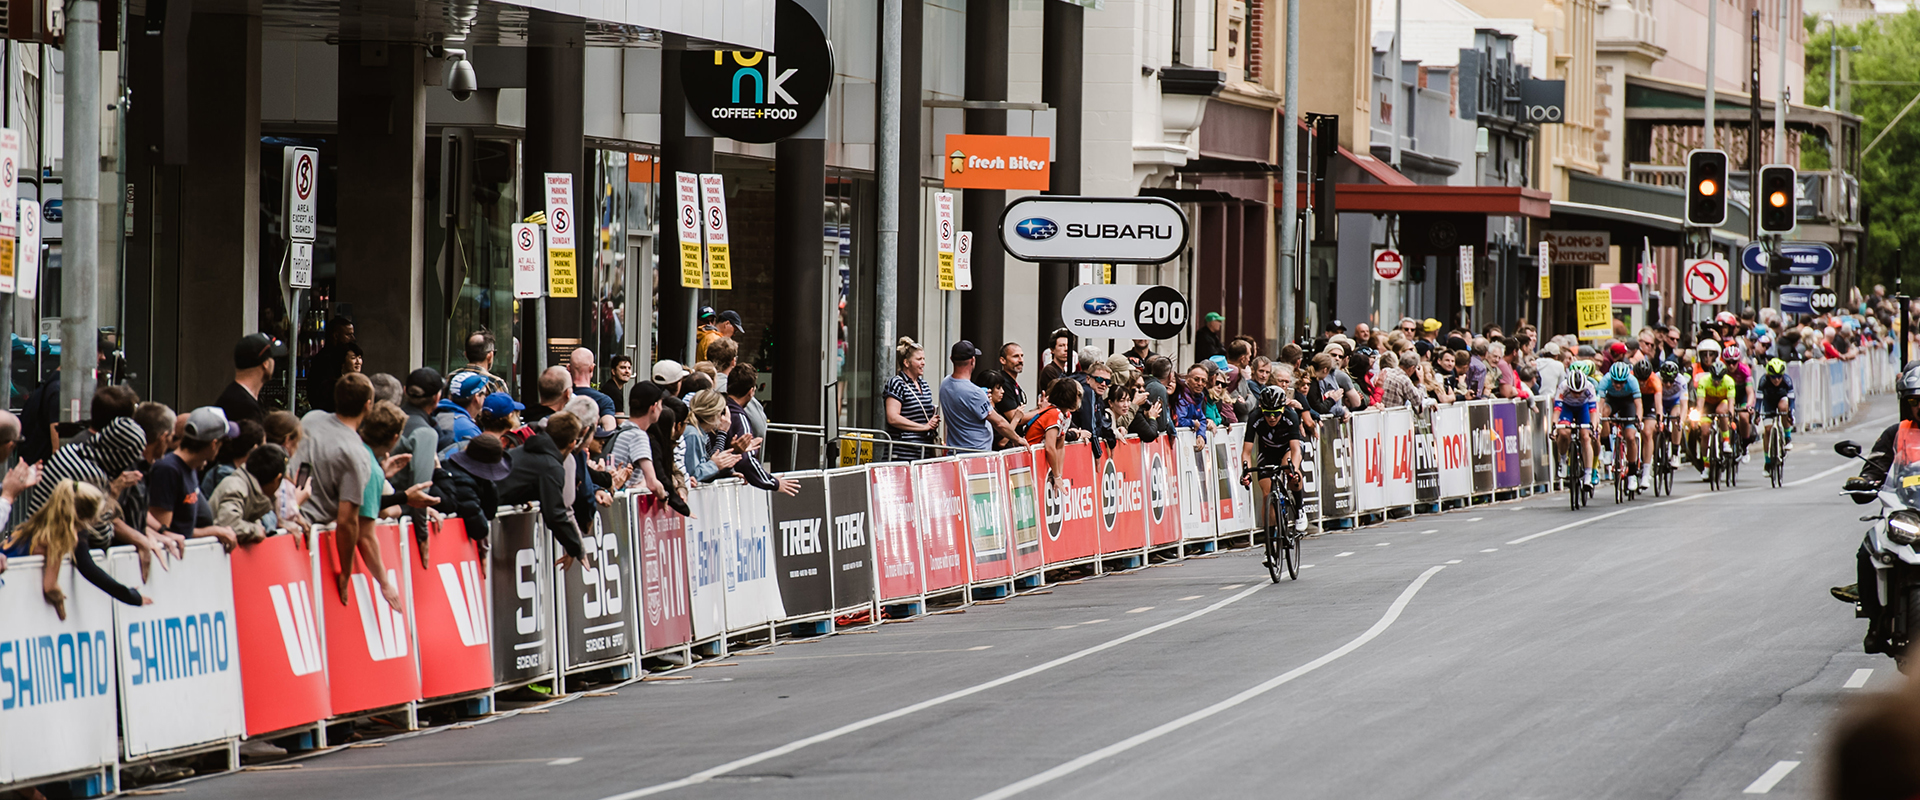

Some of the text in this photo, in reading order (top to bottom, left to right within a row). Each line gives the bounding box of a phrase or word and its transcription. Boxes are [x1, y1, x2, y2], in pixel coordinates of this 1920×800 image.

[712, 107, 798, 120] COFFEE+FOOD
[968, 155, 1045, 170] Fresh Bites
[297, 204, 310, 212] AREA
[292, 214, 314, 224] EXCEPT AS
[296, 225, 311, 234] SIGNED
[683, 231, 696, 239] SUNDAY
[1066, 224, 1172, 239] SUBARU
[1558, 252, 1607, 261] KITCHEN
[1812, 293, 1836, 307] 300
[1139, 301, 1185, 325] 200
[1582, 304, 1607, 312] KEEP
[1074, 319, 1126, 328] SUBARU
[1584, 313, 1606, 321] LEFT
[1102, 473, 1117, 515] 99
[1152, 468, 1163, 508] 99
[1046, 482, 1061, 524] 99
[779, 518, 822, 557] TREK
[835, 512, 865, 551] TREK
[659, 537, 685, 620] GIN
[128, 610, 228, 686] SHIMANO
[586, 638, 605, 652] SCIENCE
[606, 636, 612, 648] IN
[516, 655, 538, 669] SCIENCE
[0, 630, 108, 710] SHIMANO
